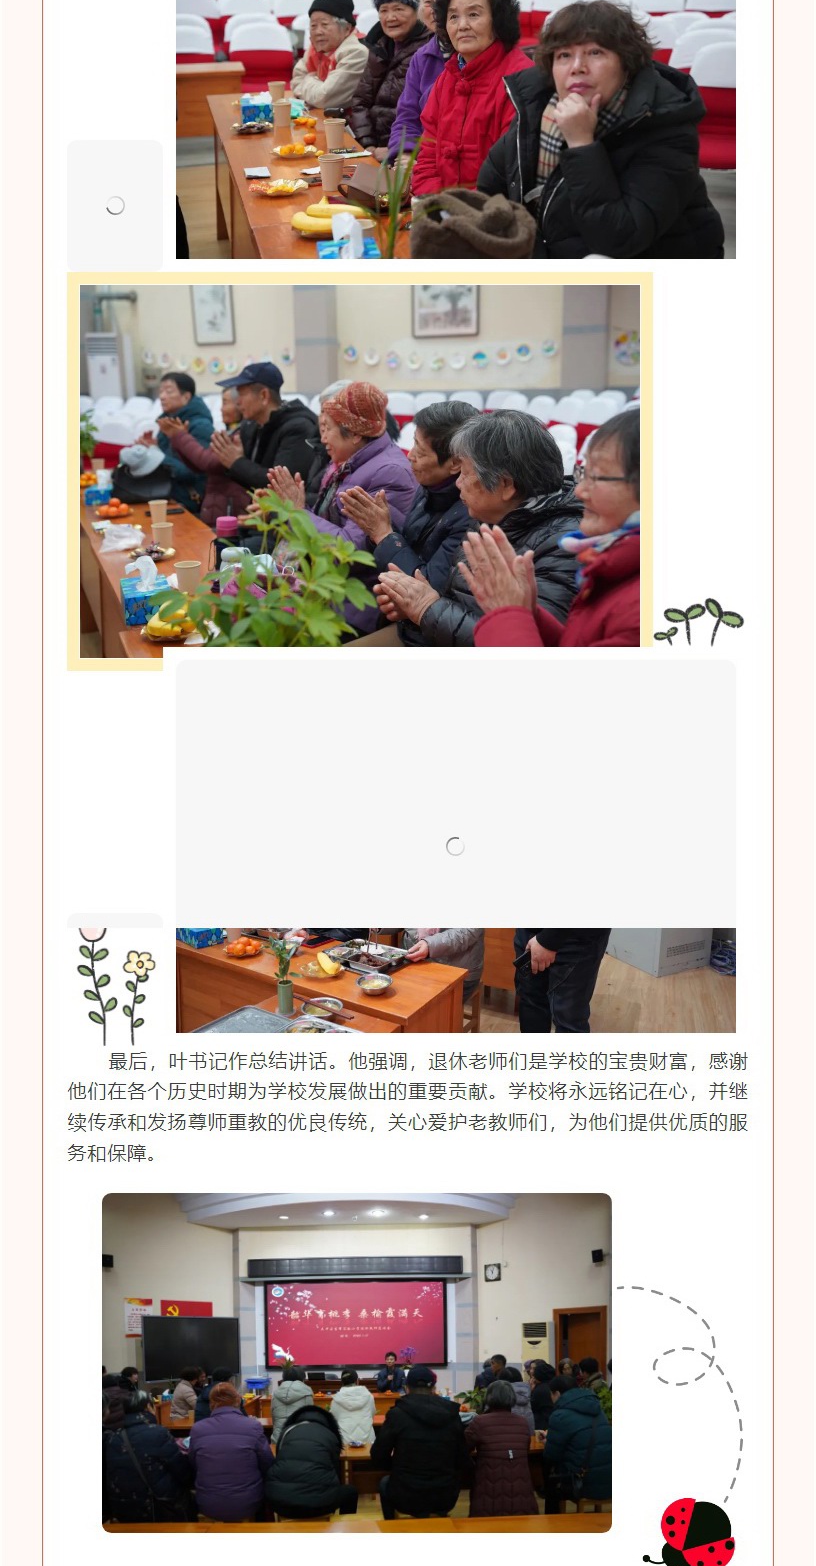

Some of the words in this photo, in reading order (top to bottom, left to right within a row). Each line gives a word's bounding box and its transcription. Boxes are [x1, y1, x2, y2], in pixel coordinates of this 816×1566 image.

[108, 1050, 749, 1072] 最后，叶书记作总结讲话。他强调，退休老师们是学校的宝贵财富，感谢
[67, 1080, 748, 1102] 他们在各个历史时期为学校发展做出的重要贡献。学校将永远铭记在心，并继
[67, 1111, 749, 1133] 续传承和发扬尊师重教的优良传统，关心爱护老教师们，为他们提供优质的服
[67, 1143, 156, 1163] 务和保障。
